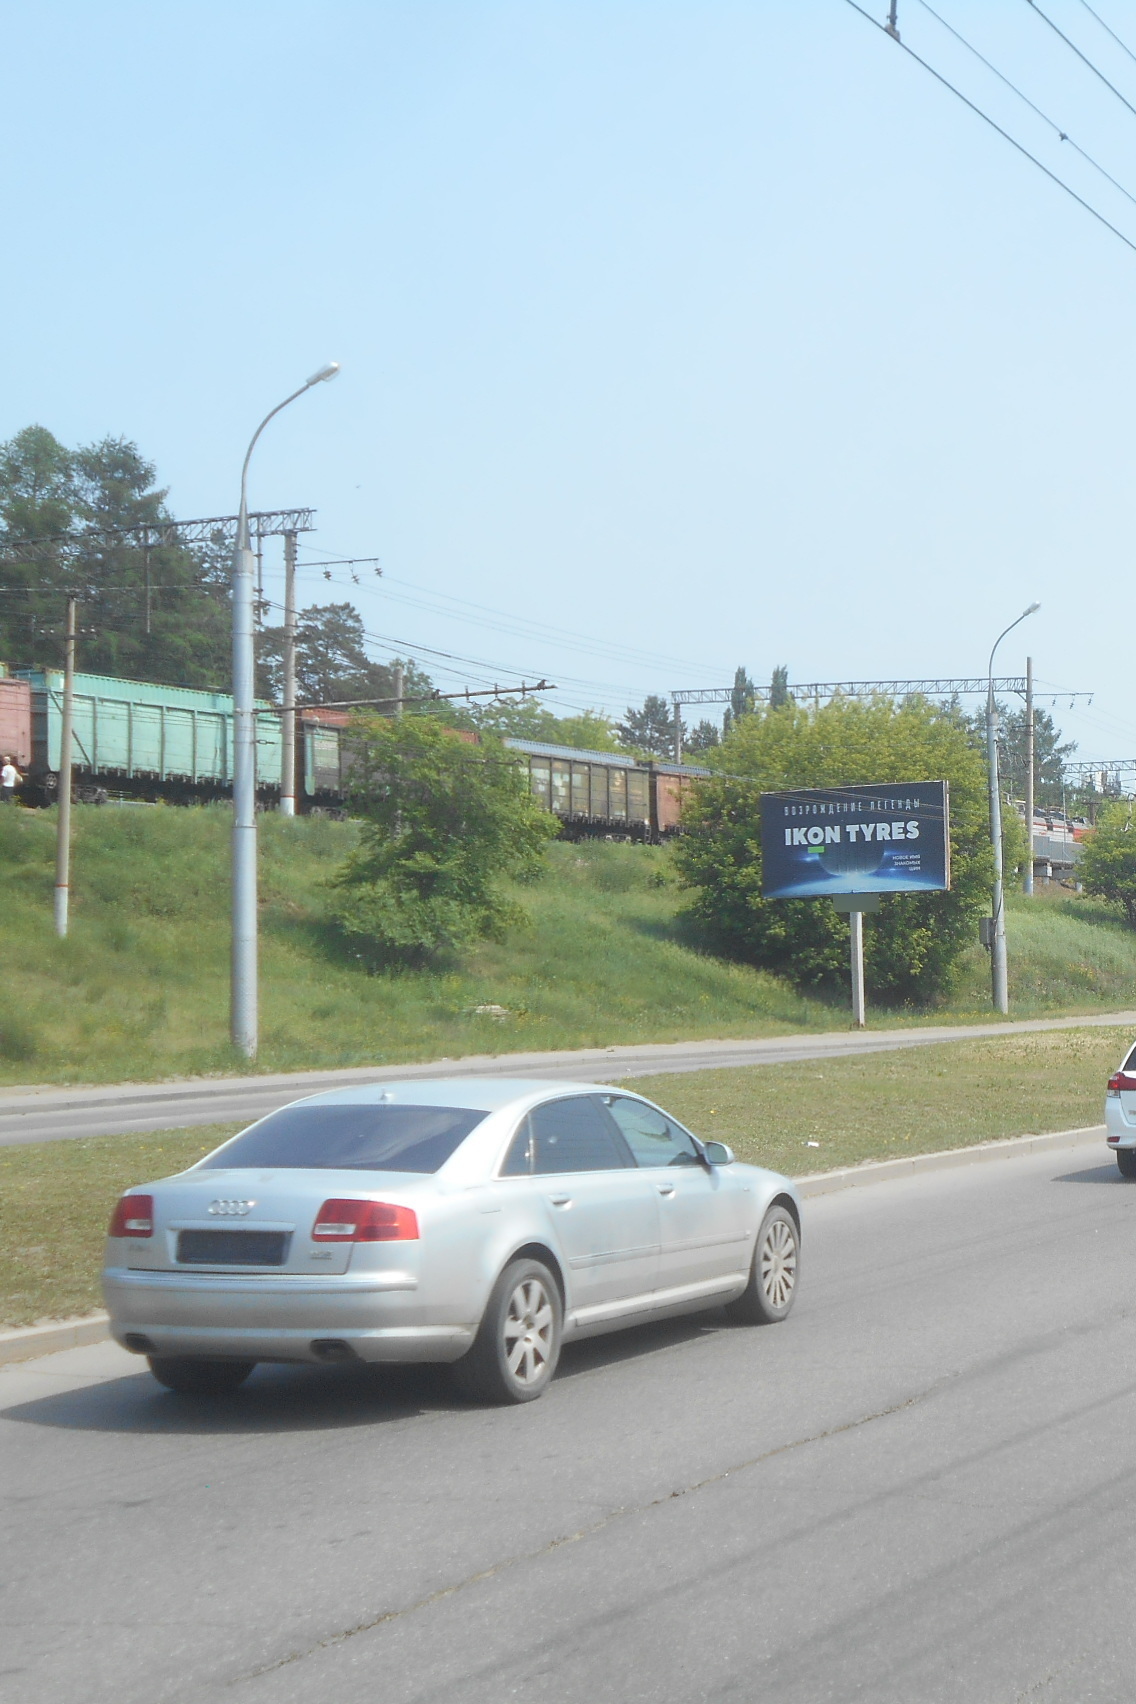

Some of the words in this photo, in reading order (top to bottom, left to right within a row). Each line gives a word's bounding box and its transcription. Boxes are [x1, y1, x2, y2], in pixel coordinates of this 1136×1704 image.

[784, 802, 862, 816] ВОЗРОЖДЕНИЕ
[870, 798, 920, 811] ЛЕГЕНДЫ
[784, 825, 841, 846] IKON
[845, 820, 920, 842] TYRES
